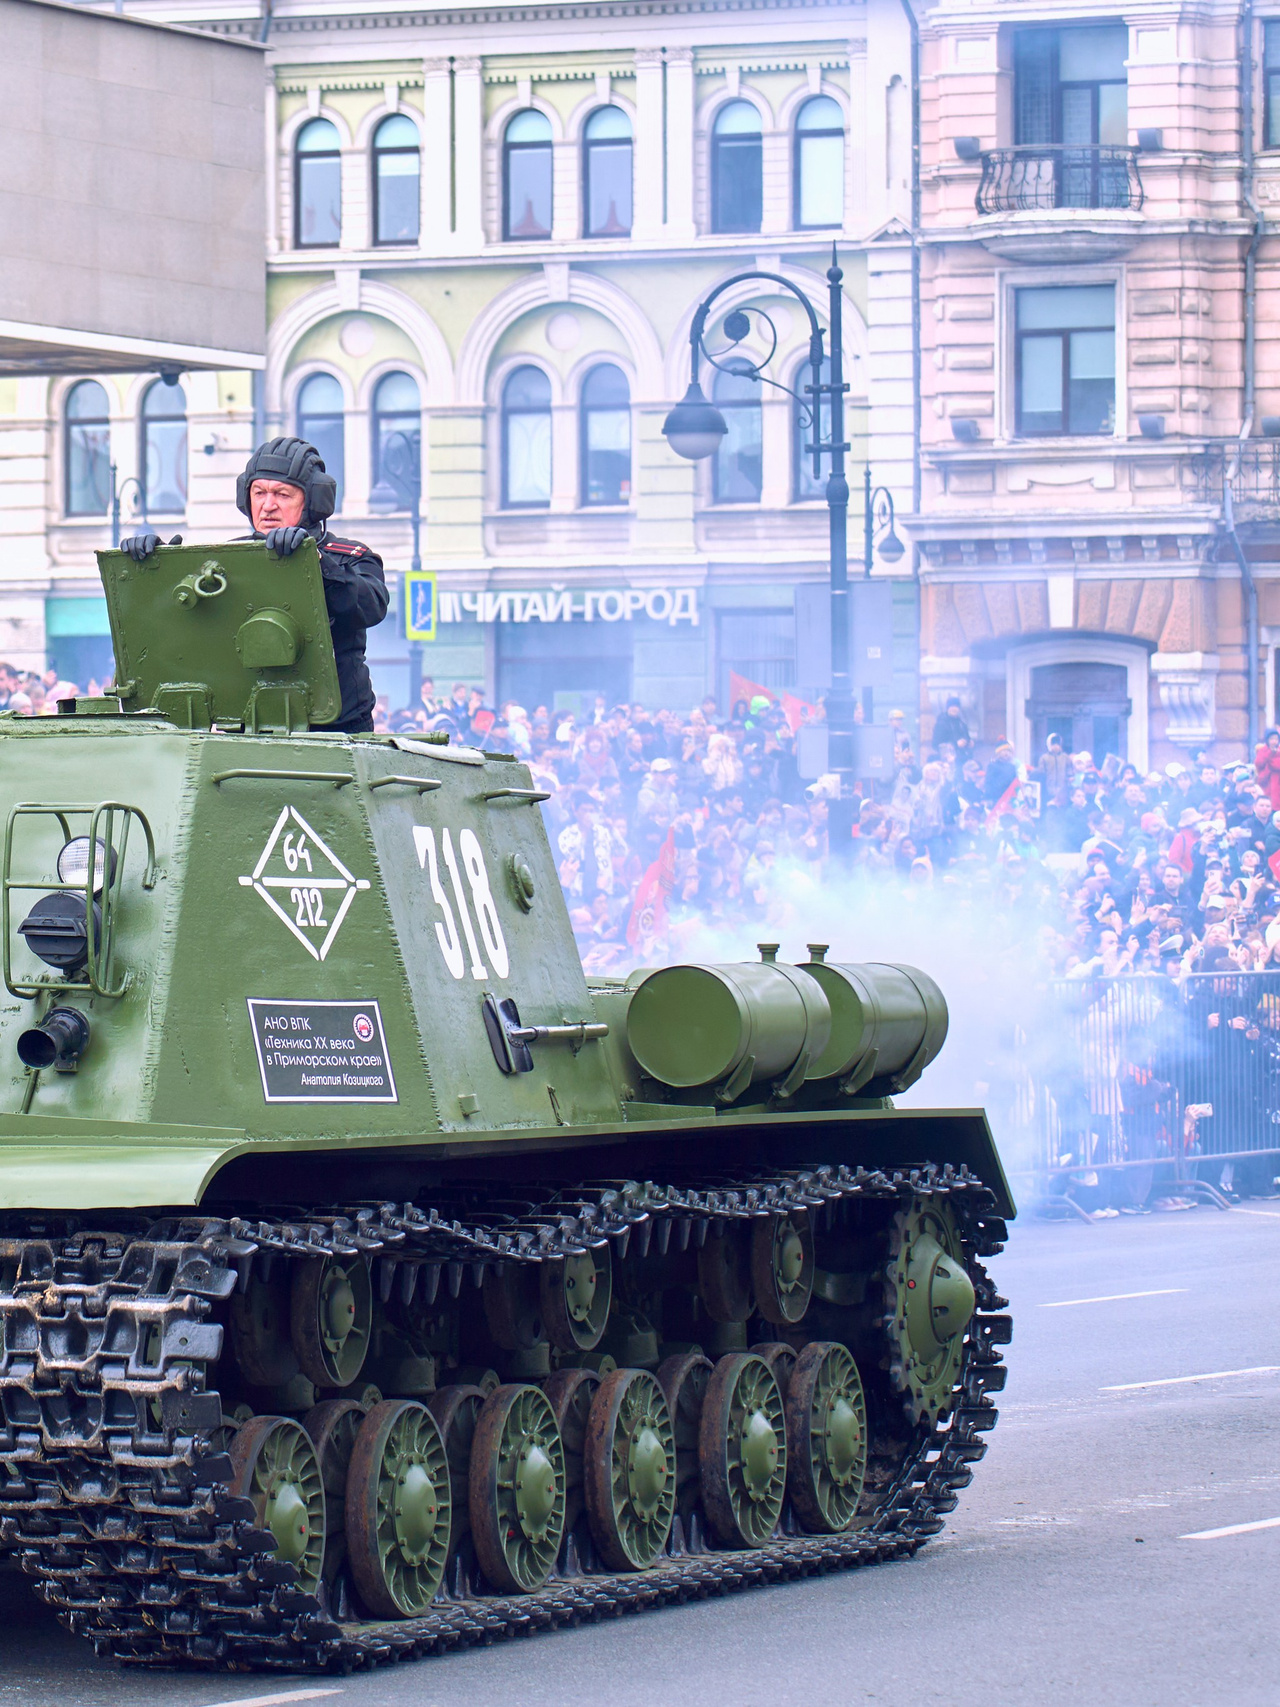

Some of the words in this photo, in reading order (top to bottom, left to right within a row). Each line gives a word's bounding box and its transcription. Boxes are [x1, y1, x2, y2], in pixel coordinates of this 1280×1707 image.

[461, 583, 699, 626] ЧИТАЙ-ГОРОД
[283, 832, 314, 873] 64
[291, 887, 328, 927] 212
[412, 825, 510, 980] 318
[263, 1016, 289, 1031] АНО
[290, 1017, 312, 1031] ВПК
[264, 1035, 312, 1050] «Техника
[329, 1039, 356, 1050] века
[266, 1054, 273, 1066] в
[273, 1052, 349, 1069] Приморском
[349, 1055, 383, 1069] крае»
[300, 1072, 342, 1086] Анатолия
[342, 1073, 384, 1087] Козицкого
